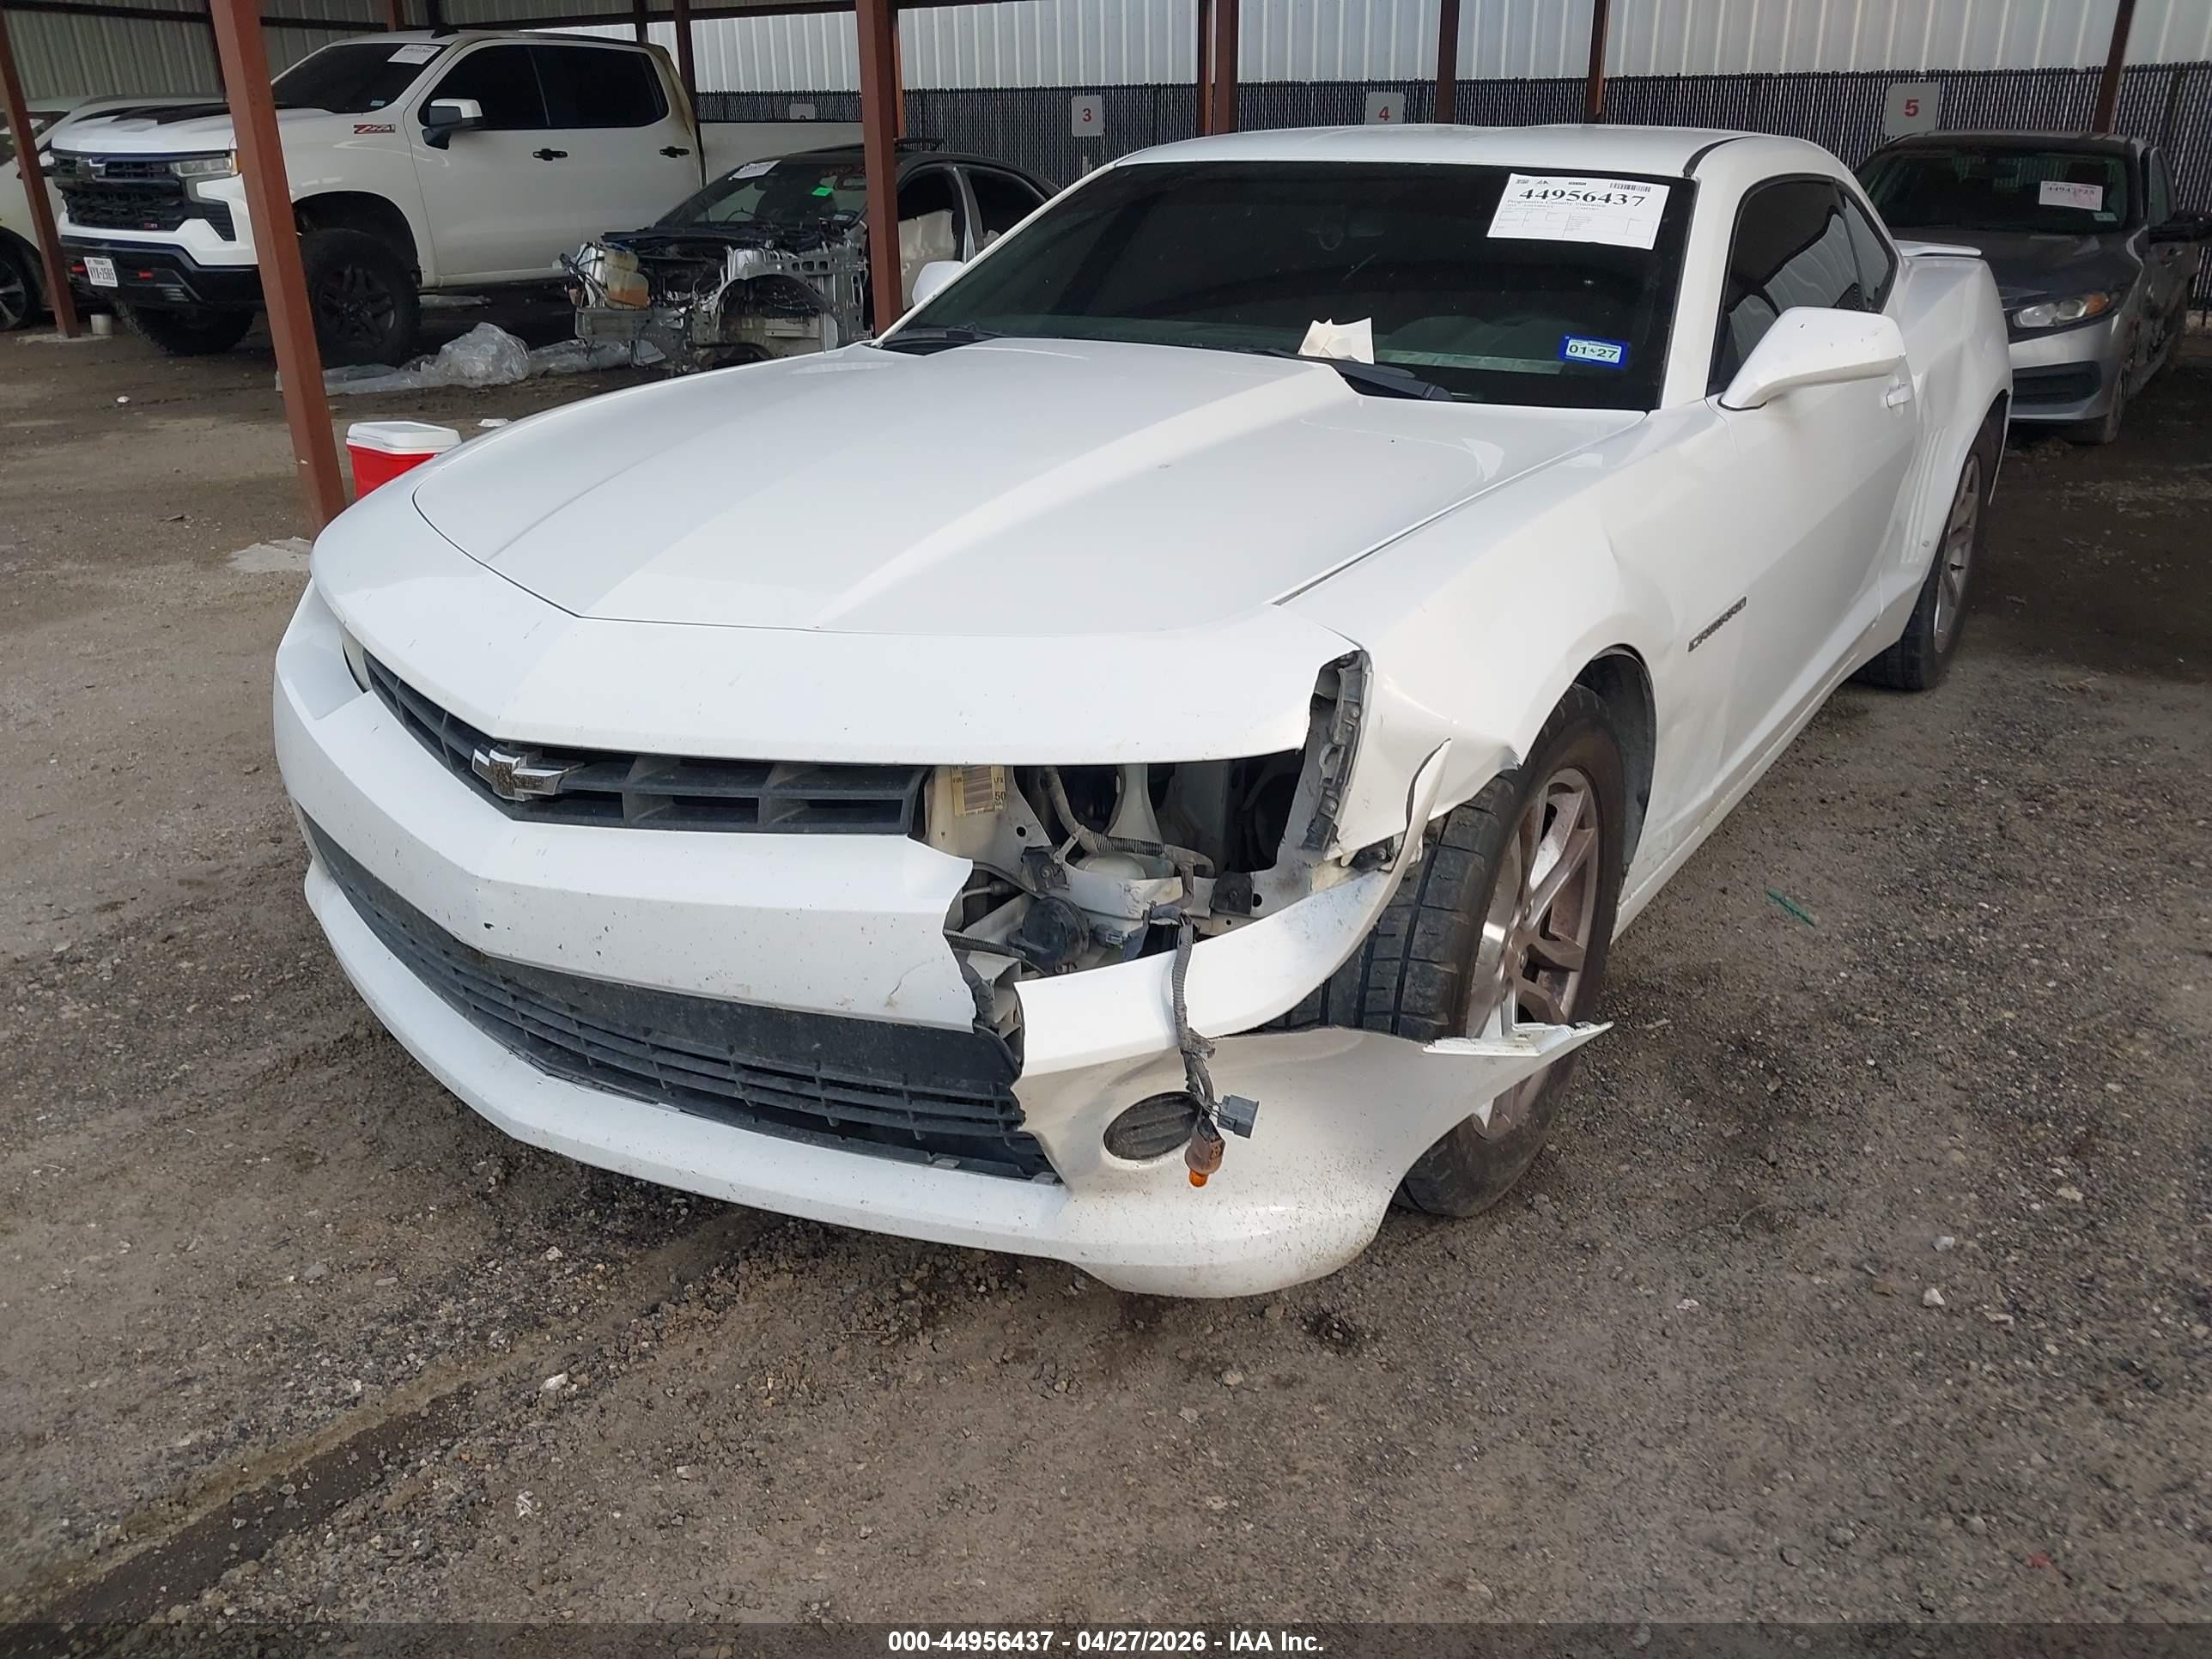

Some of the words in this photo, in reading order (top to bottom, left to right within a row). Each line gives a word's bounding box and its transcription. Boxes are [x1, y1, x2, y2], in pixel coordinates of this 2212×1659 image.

[1083, 108, 1091, 122] 3
[1379, 106, 1390, 121] 4
[1905, 99, 1919, 117] 5
[1519, 188, 1646, 207] 44956437
[1569, 344, 1587, 355] 01
[1597, 348, 1618, 358] 27
[994, 791, 1007, 801] 50
